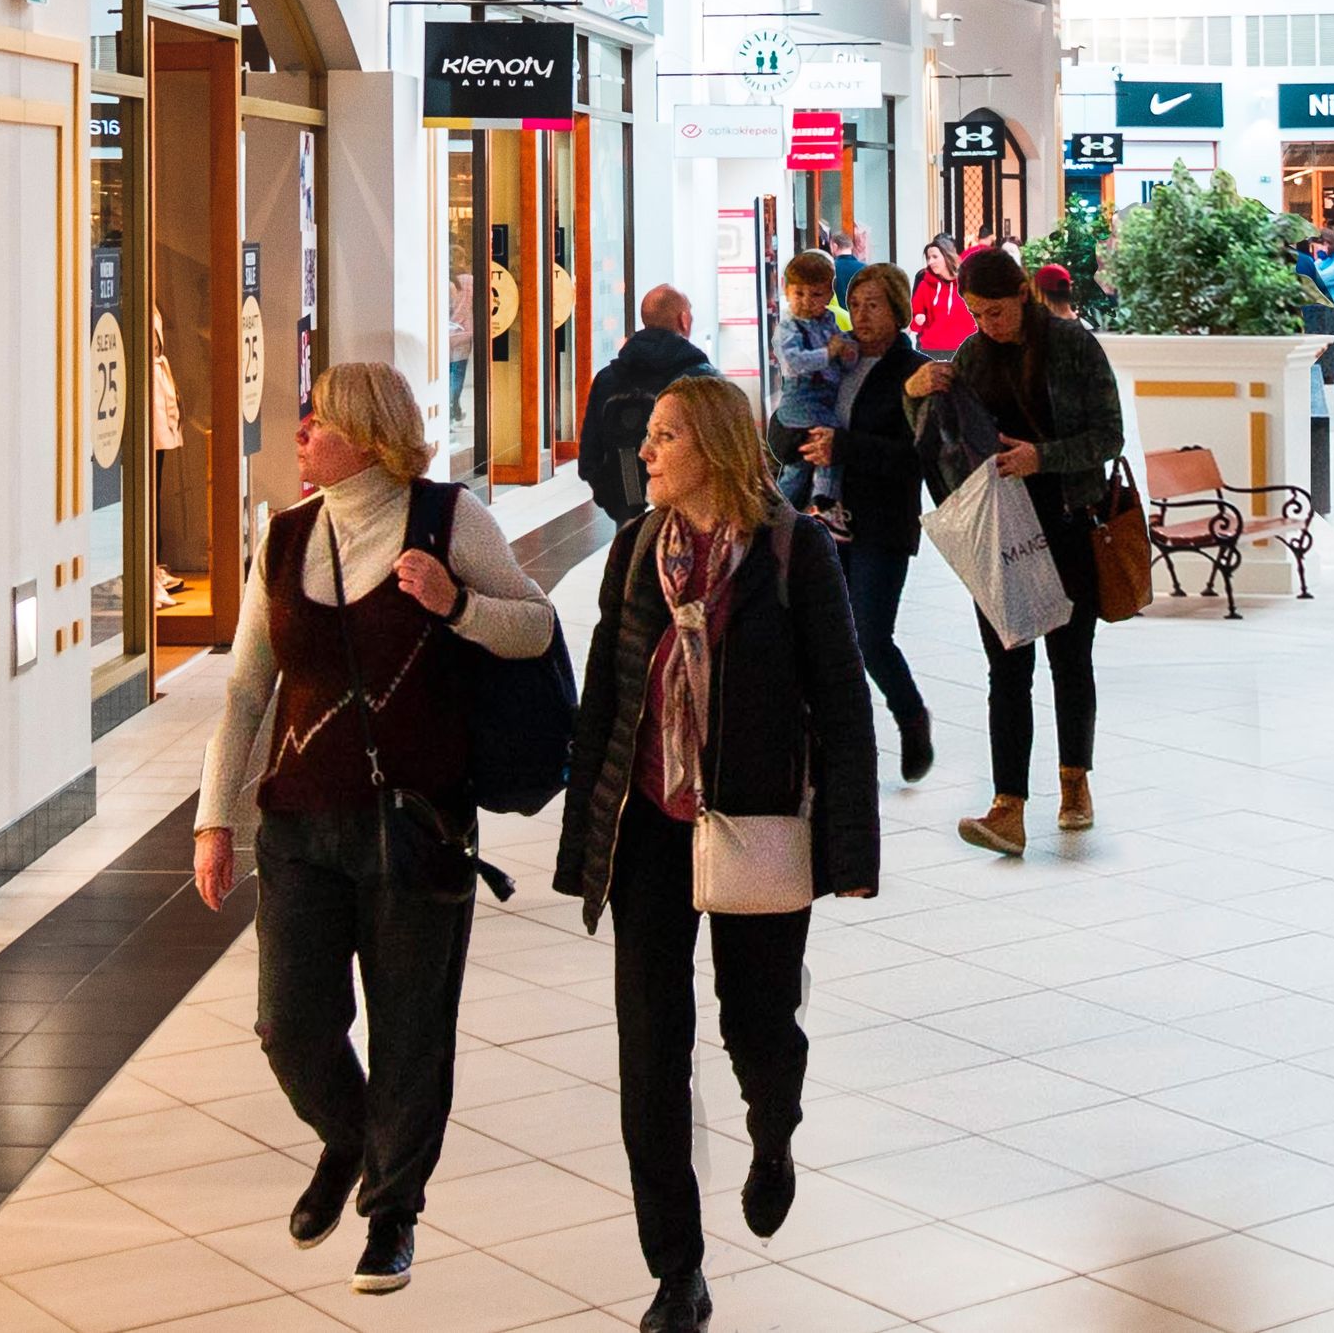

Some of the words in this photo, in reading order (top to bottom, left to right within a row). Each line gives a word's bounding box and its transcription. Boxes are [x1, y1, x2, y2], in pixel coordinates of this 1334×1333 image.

[462, 79, 534, 87] AURUM
[809, 81, 867, 89] GANT
[96, 335, 117, 352] SLEVA
